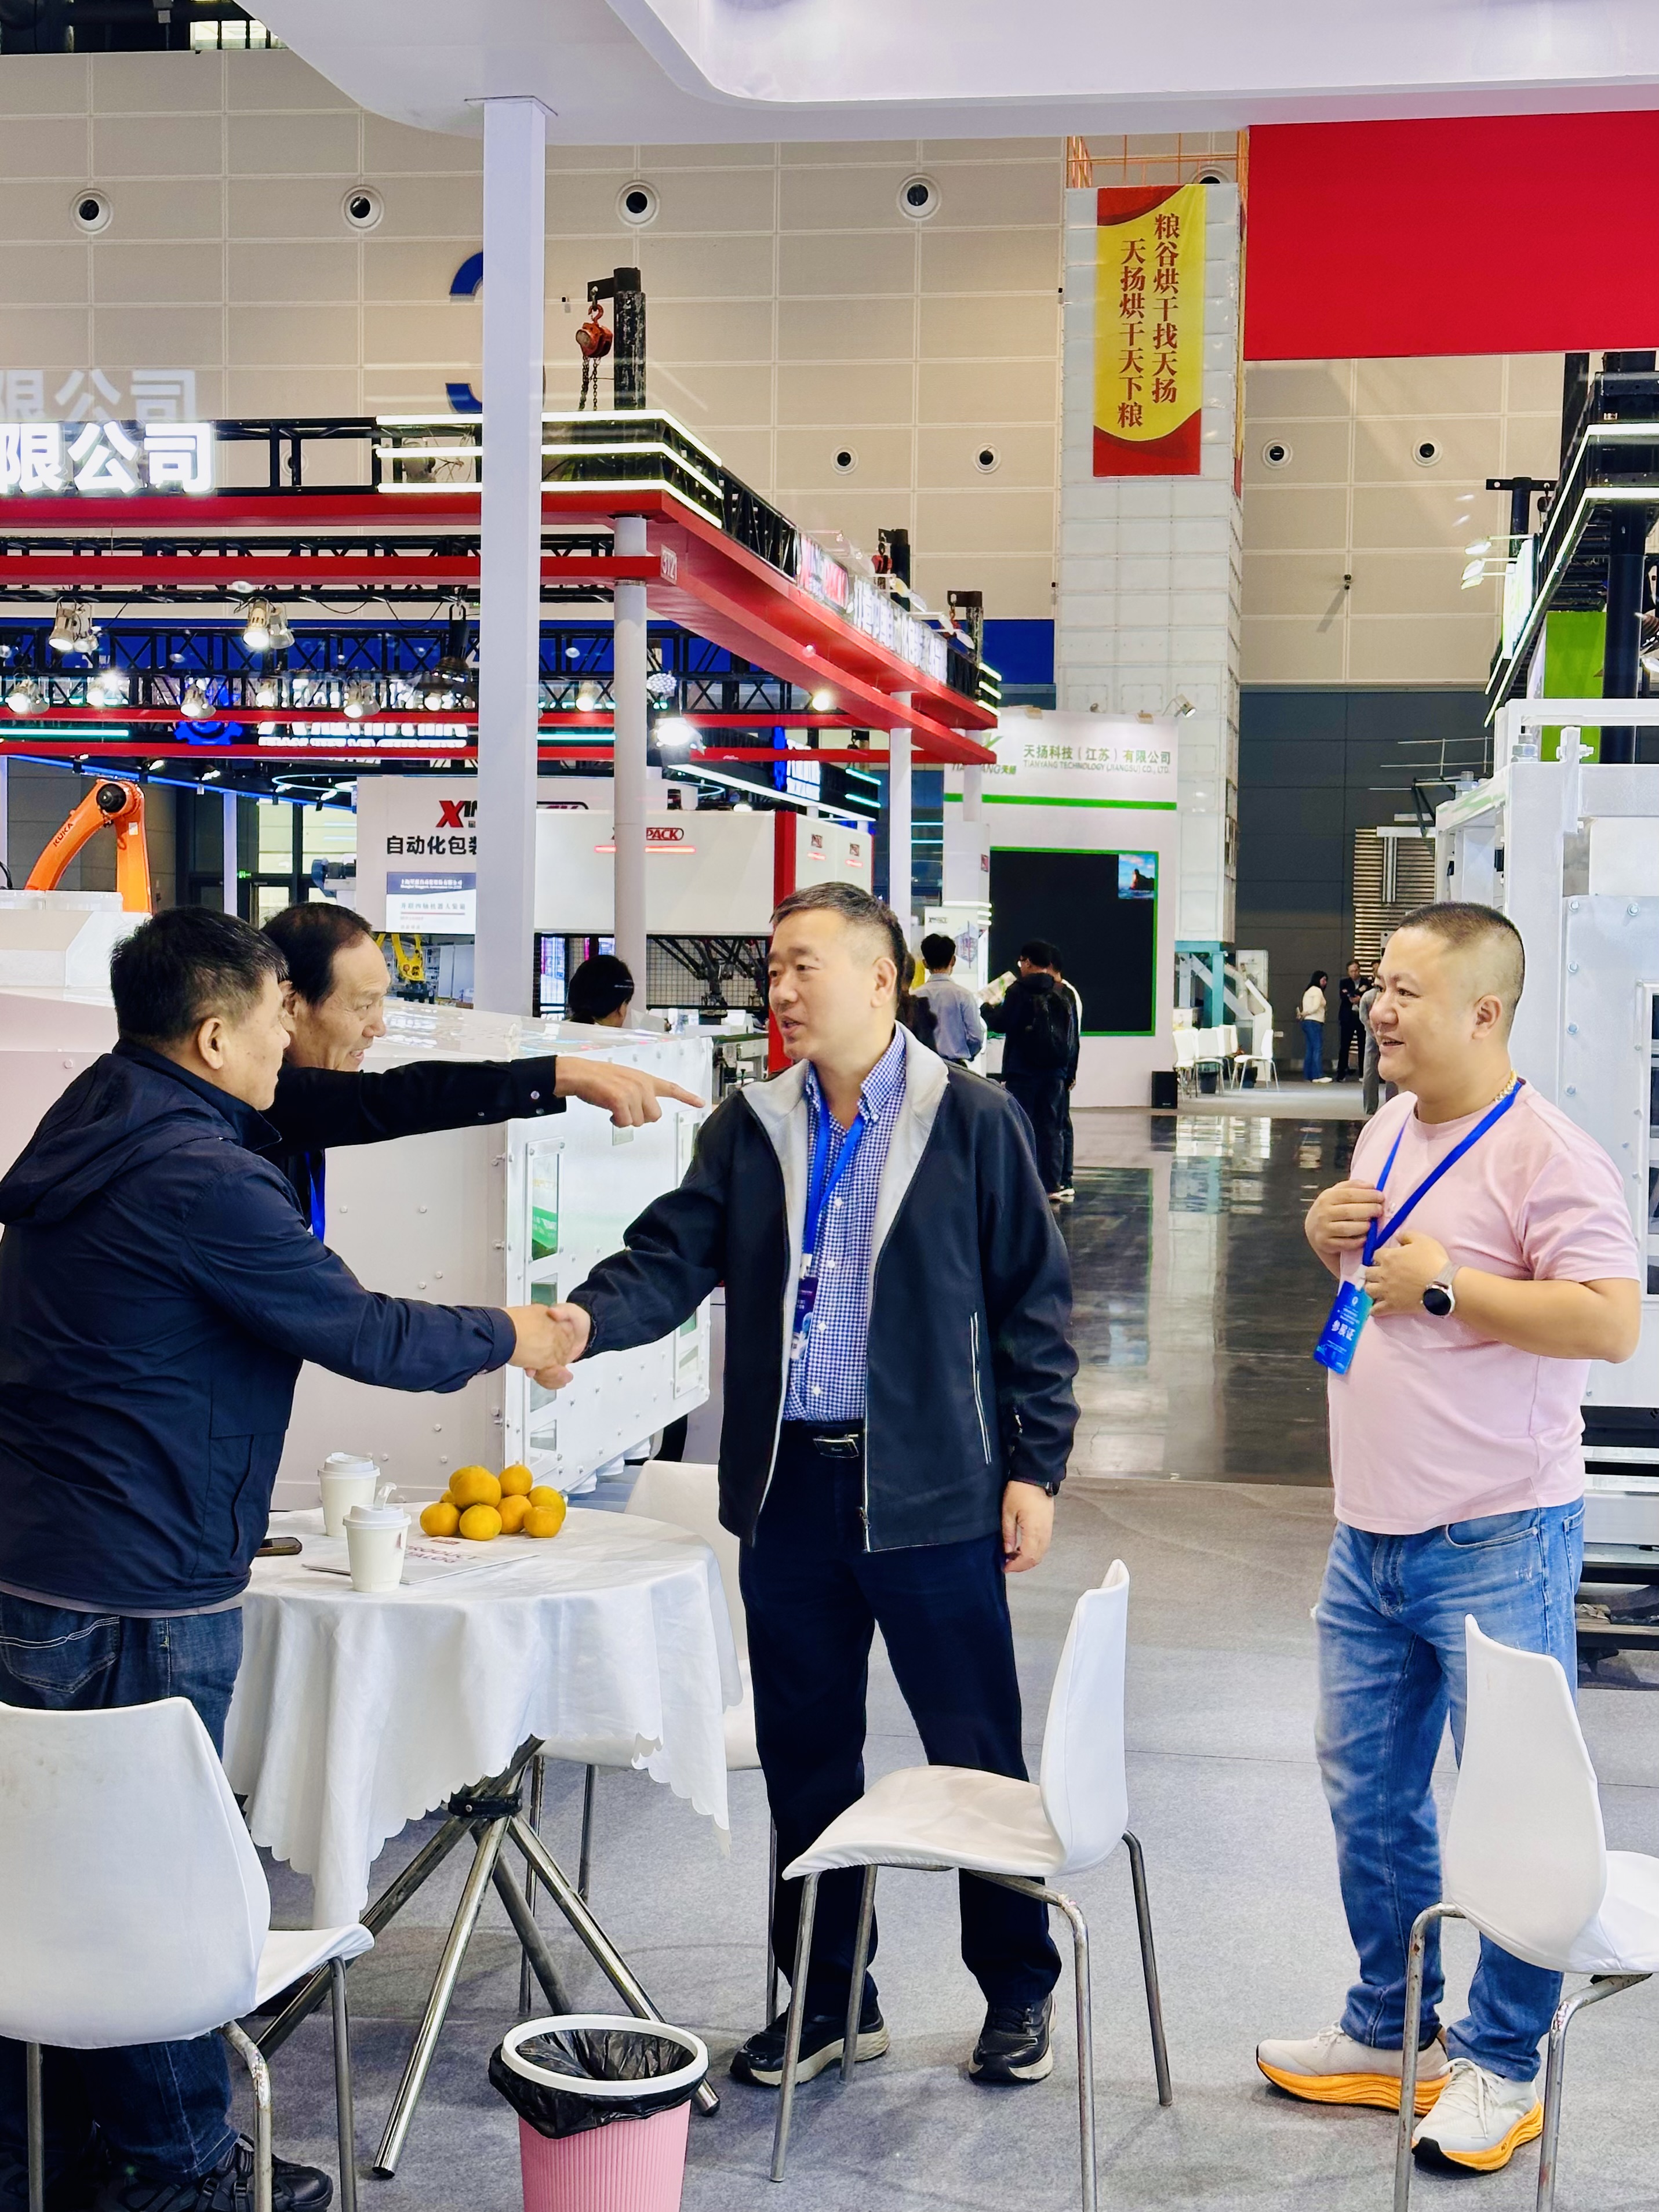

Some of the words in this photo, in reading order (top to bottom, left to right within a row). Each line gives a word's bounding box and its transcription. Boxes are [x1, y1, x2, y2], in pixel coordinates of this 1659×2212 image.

[1116, 238, 1146, 428] 天扬烘干天下粮
[1151, 213, 1180, 404] 粮谷烘干找天扬
[0, 421, 212, 493] 限公司
[1023, 759, 1058, 769] TIANYANG
[1060, 761, 1105, 771] TECHNOLOGY
[53, 823, 74, 847] KUKA
